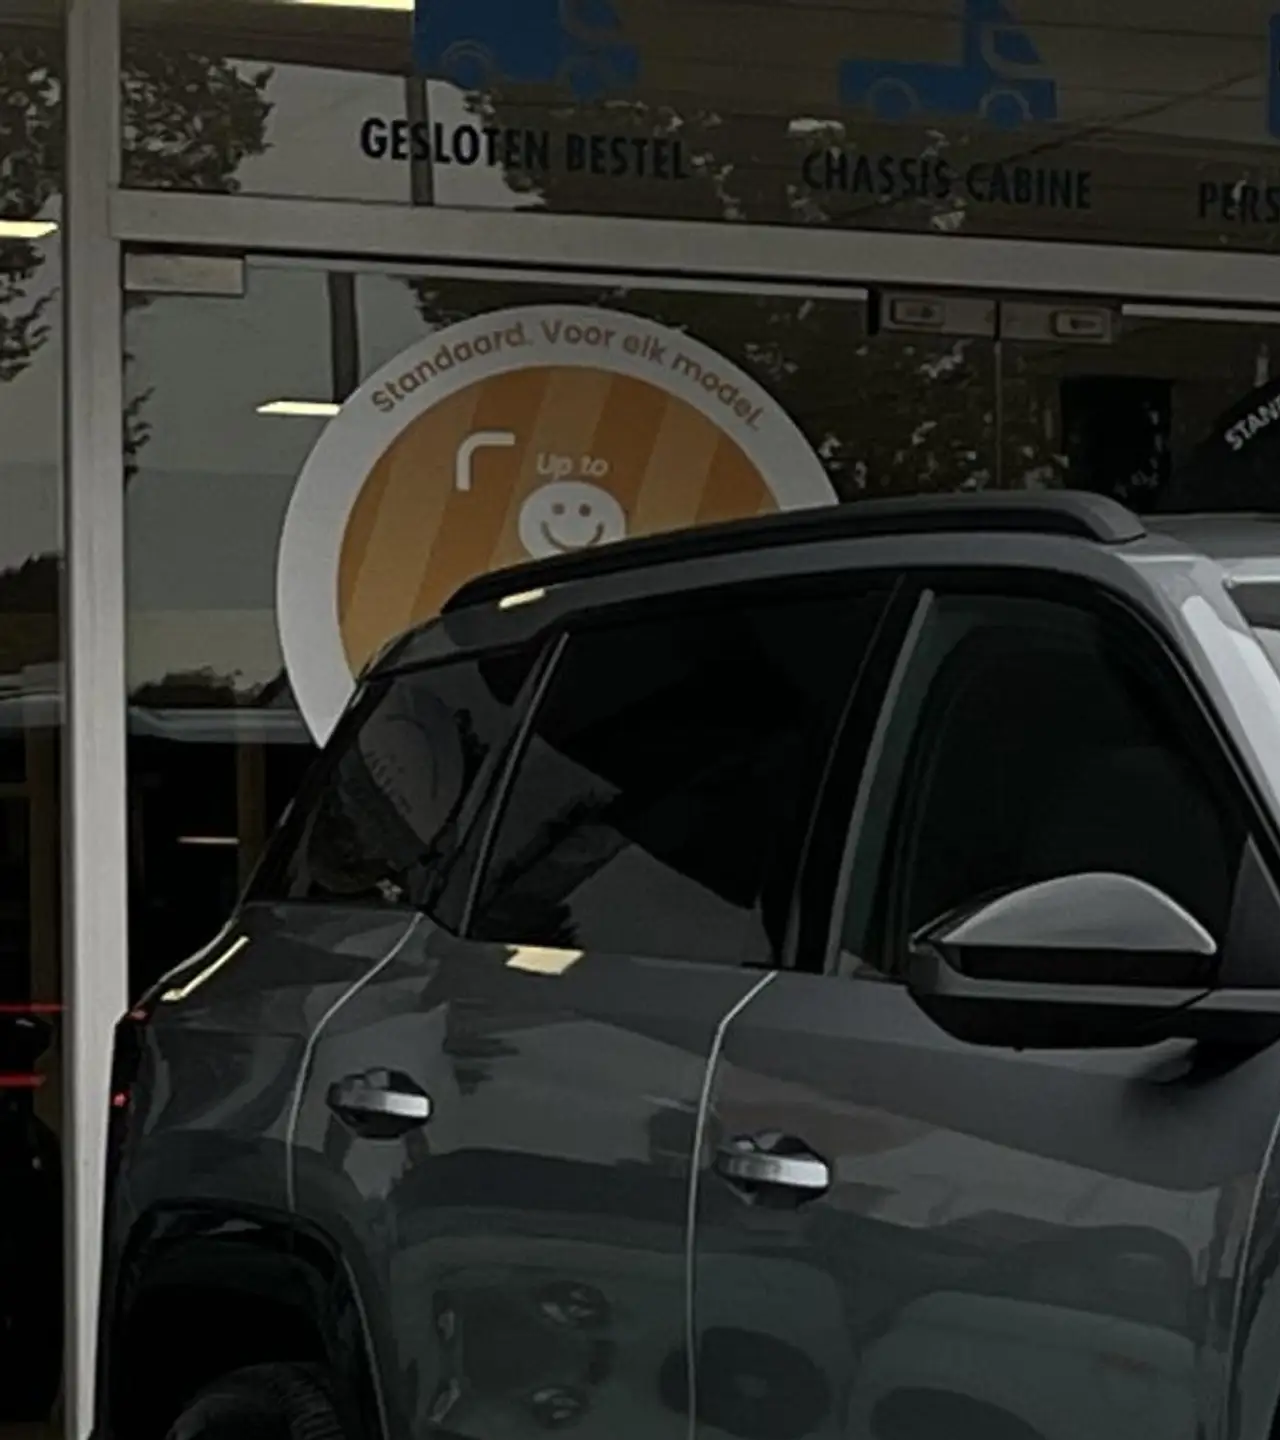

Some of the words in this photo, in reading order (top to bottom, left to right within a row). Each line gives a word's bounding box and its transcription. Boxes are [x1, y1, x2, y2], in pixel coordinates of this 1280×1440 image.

[361, 117, 550, 171] GESLOTEN
[565, 132, 692, 181] BESTEL
[802, 150, 950, 199] CHASSIS
[966, 161, 1092, 210] CABINE
[371, 321, 533, 414] Standaard.
[541, 319, 615, 348] Voor
[622, 329, 666, 366] elk
[535, 452, 573, 478] Up
[579, 454, 609, 477] to
